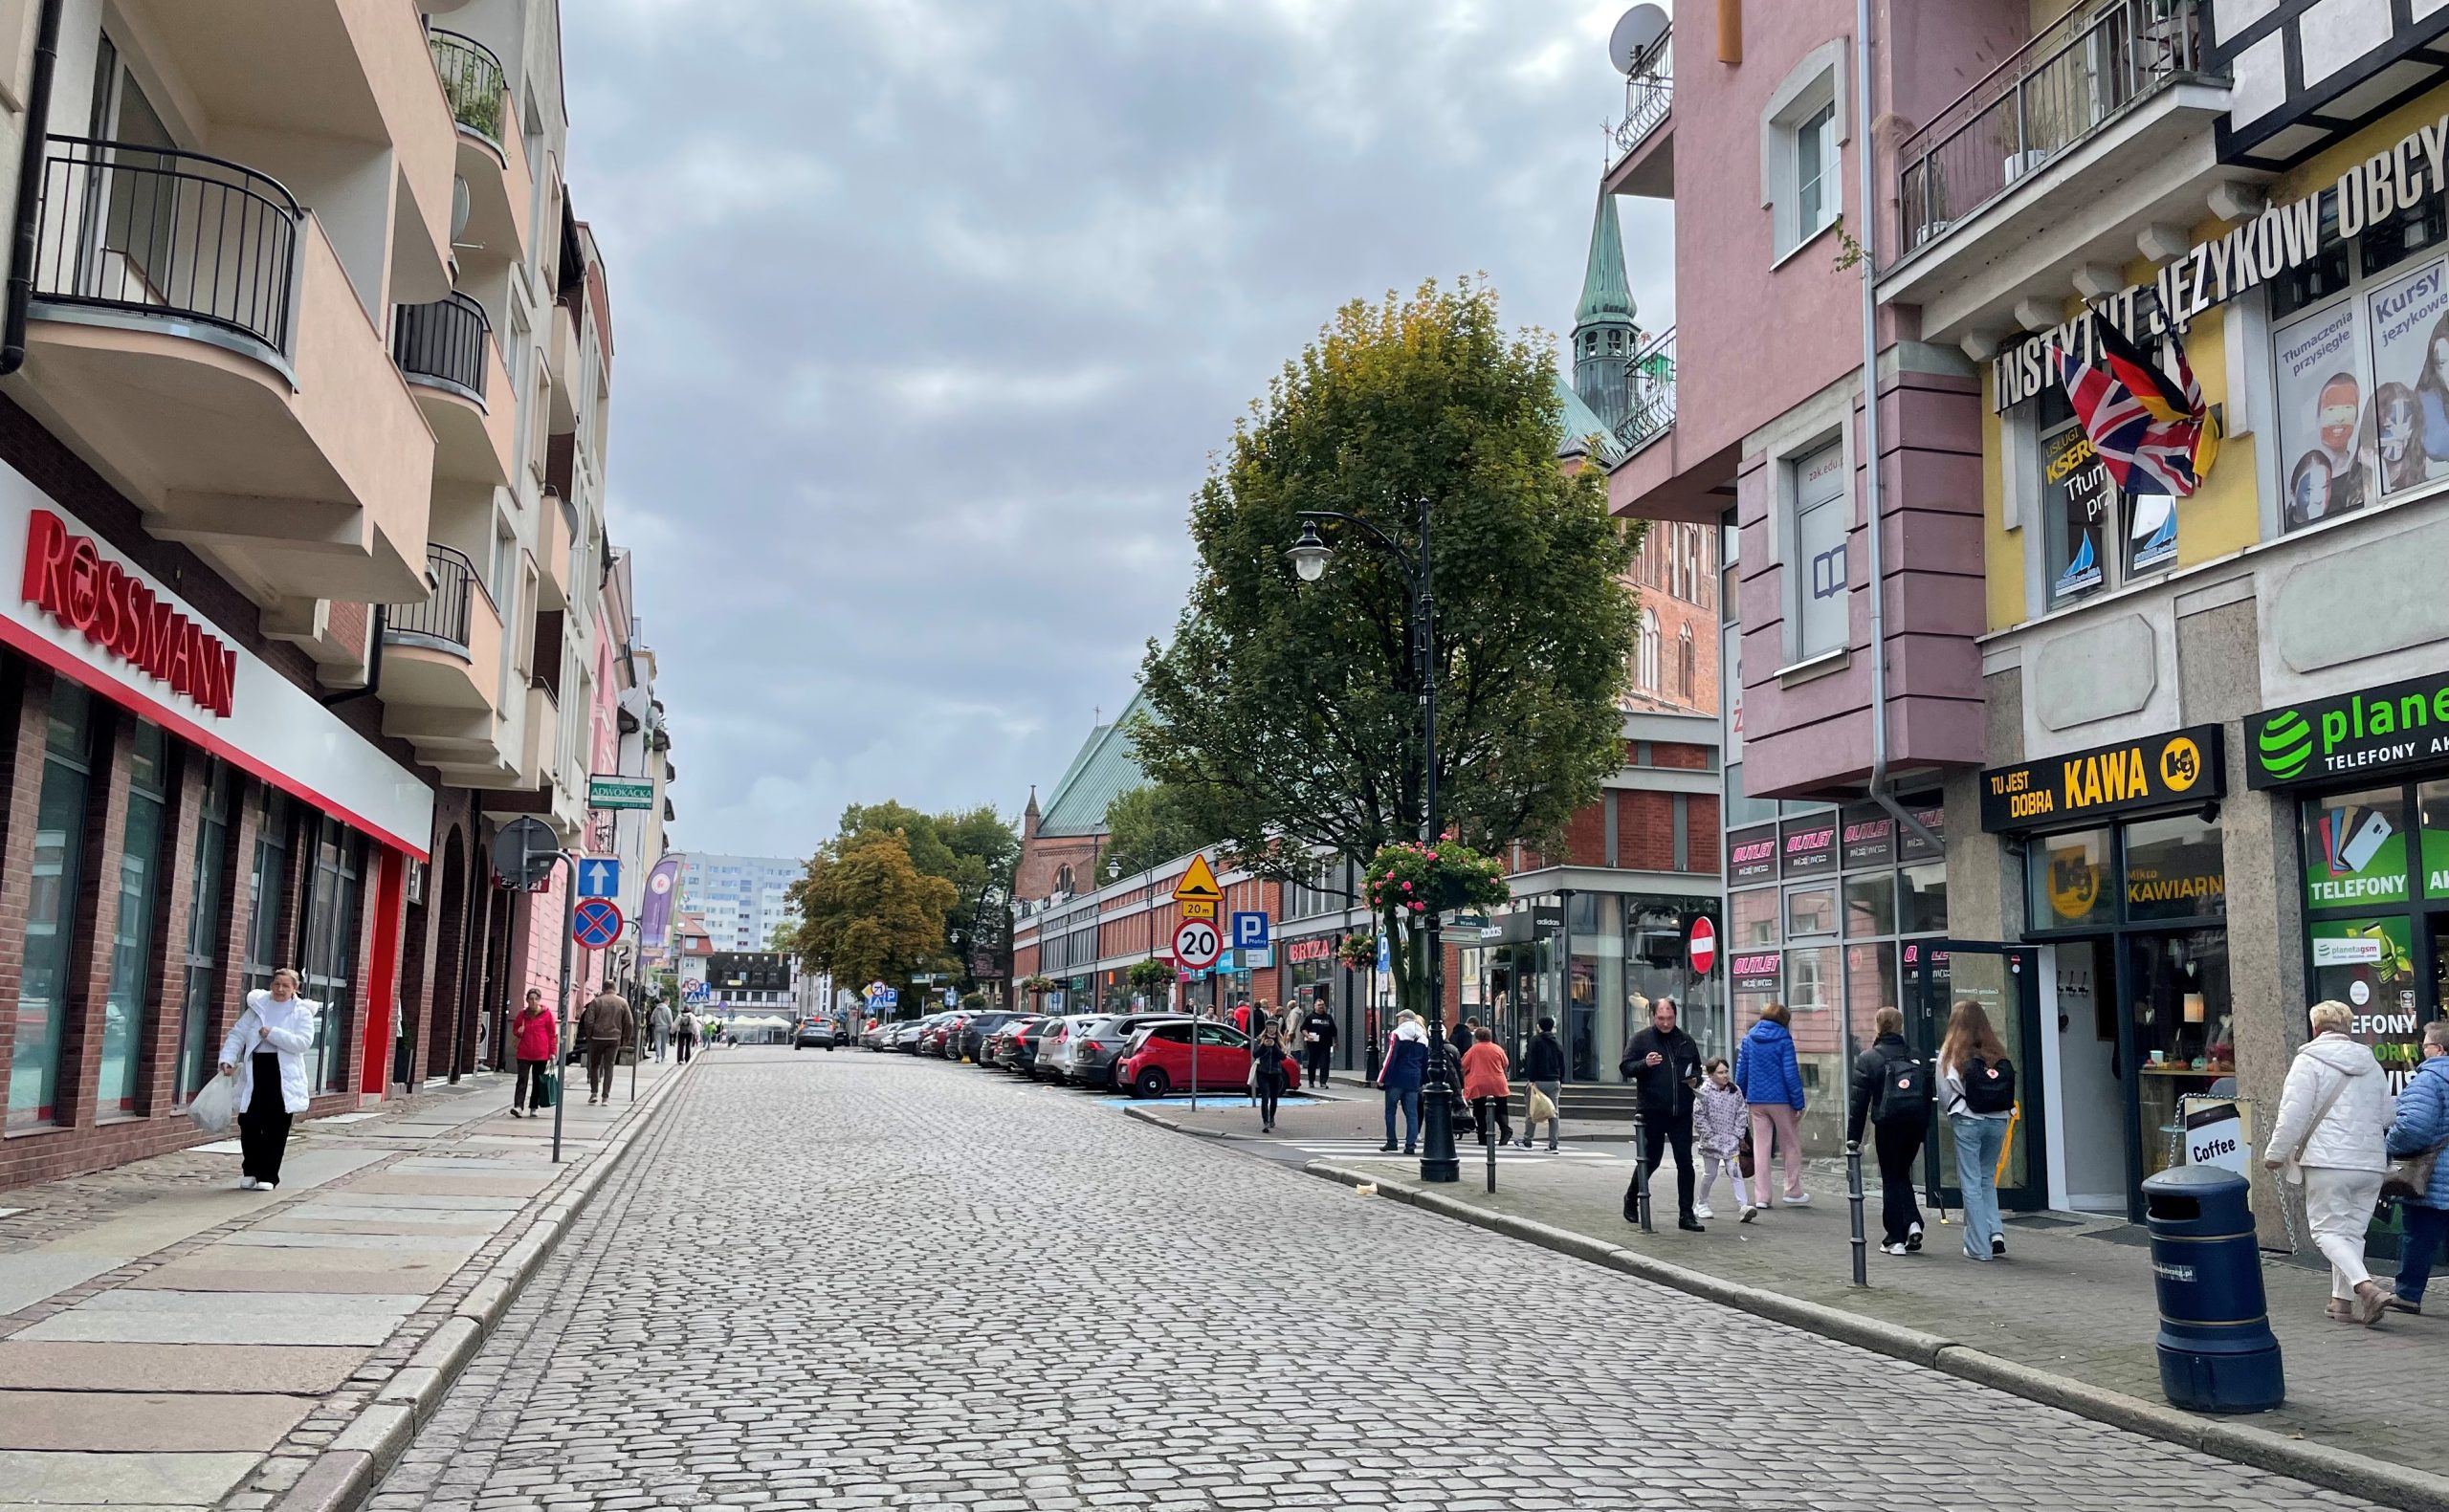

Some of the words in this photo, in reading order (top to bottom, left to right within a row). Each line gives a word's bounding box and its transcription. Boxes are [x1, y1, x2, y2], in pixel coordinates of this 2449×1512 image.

[2150, 189, 2320, 335] JĘZYKÓW
[2375, 268, 2439, 324] Kursy
[2381, 291, 2448, 347] językowe
[2282, 311, 2353, 364] Tłumaczenia
[2292, 329, 2350, 377] przysięgłe
[22, 509, 237, 718] ROSSMANN
[2322, 687, 2449, 756] plane
[2325, 741, 2416, 771] TELEFONY
[1991, 775, 2004, 795] TU
[2006, 770, 2030, 794] JEST
[2063, 747, 2150, 810] KAWA
[591, 787, 652, 798] ADWOKACKA
[2011, 789, 2054, 819] DOBRA
[1786, 829, 1835, 853] OUTLET
[1843, 818, 1892, 843] OUTLET
[1732, 841, 1776, 863] OUTLET
[2128, 874, 2224, 904] KAWIARN
[2310, 874, 2407, 901] TELEFONY
[1187, 904, 1202, 913] 20
[1241, 915, 1262, 945] P
[1481, 924, 1503, 939] adidas
[1536, 917, 1560, 927] adidas
[1181, 931, 1215, 956] 20
[1289, 939, 1331, 961] BRYZA
[1379, 936, 1388, 961] P
[2331, 944, 2378, 955] planetagsm
[1733, 953, 1779, 974] OUTLET
[2350, 1014, 2417, 1034] EFONY
[2193, 1138, 2237, 1163] Coffee
